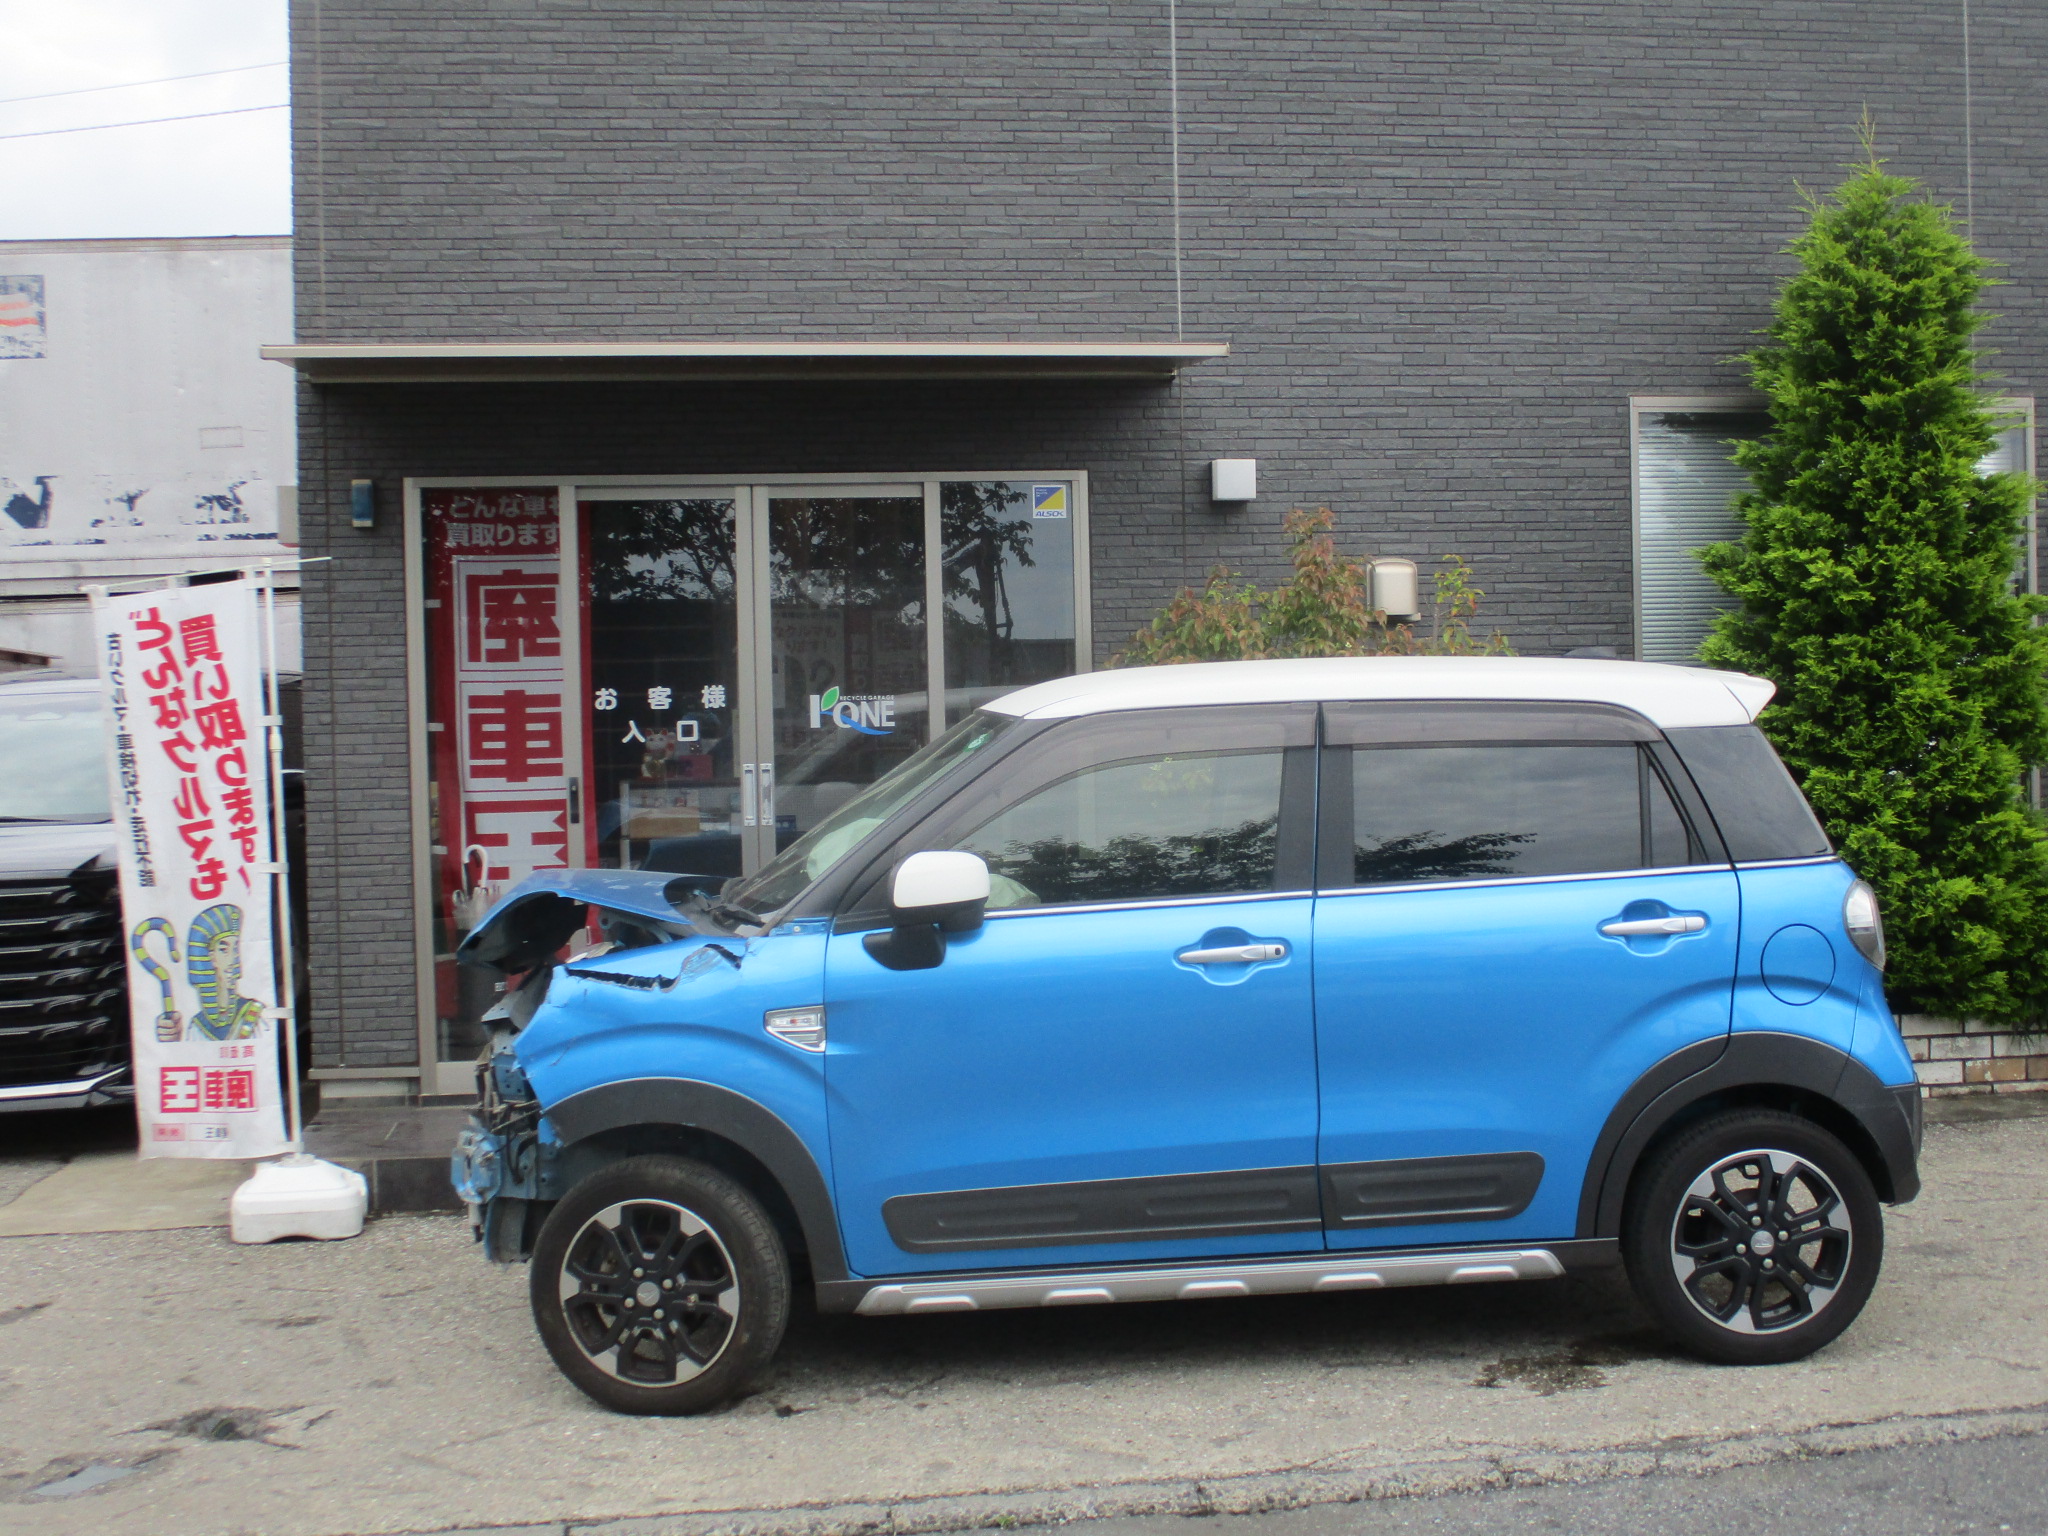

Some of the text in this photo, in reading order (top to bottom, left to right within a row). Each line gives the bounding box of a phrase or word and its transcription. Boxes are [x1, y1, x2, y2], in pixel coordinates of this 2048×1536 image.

[445, 521, 560, 547] 買取ります
[594, 685, 726, 710] お客様
[622, 720, 700, 743] 入口
